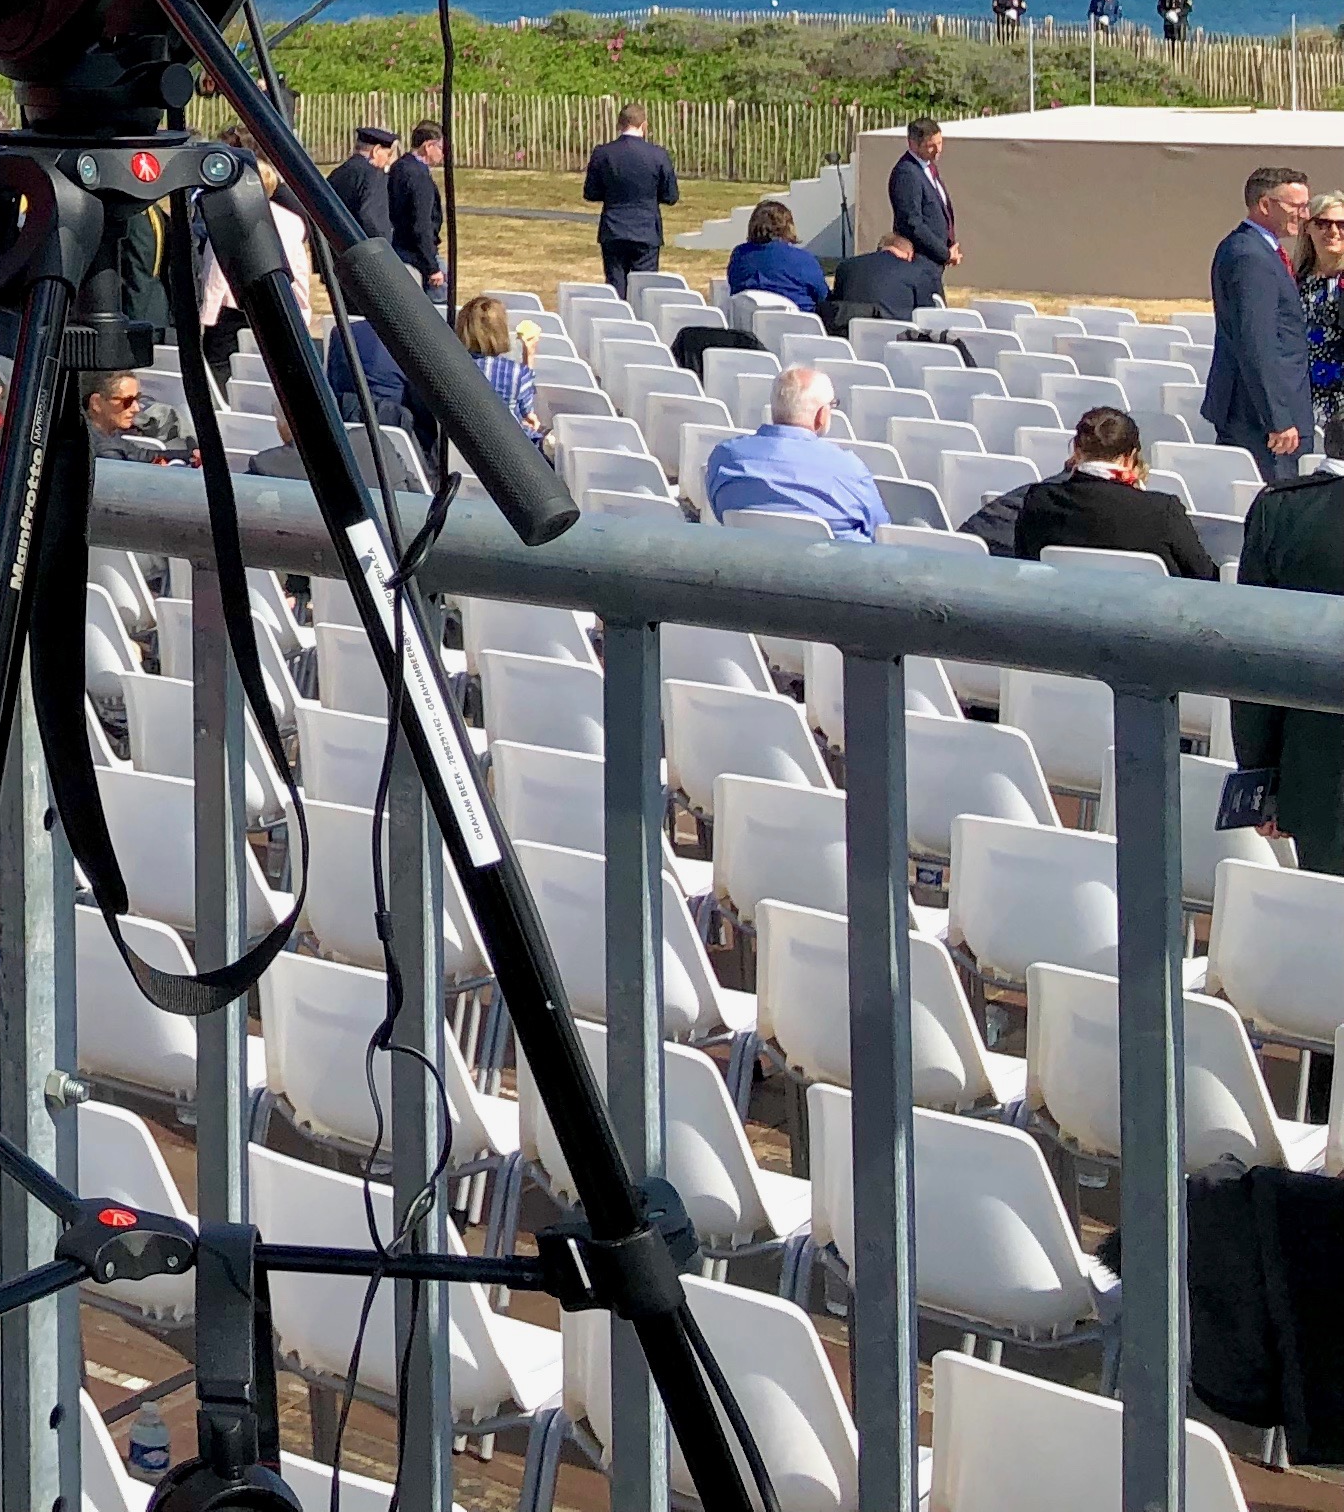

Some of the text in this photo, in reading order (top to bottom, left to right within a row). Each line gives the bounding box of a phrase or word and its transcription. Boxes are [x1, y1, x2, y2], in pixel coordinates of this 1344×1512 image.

[10, 447, 43, 591] Manfrotto
[454, 773, 469, 797] BEER
[464, 798, 484, 841] GRAHAM
